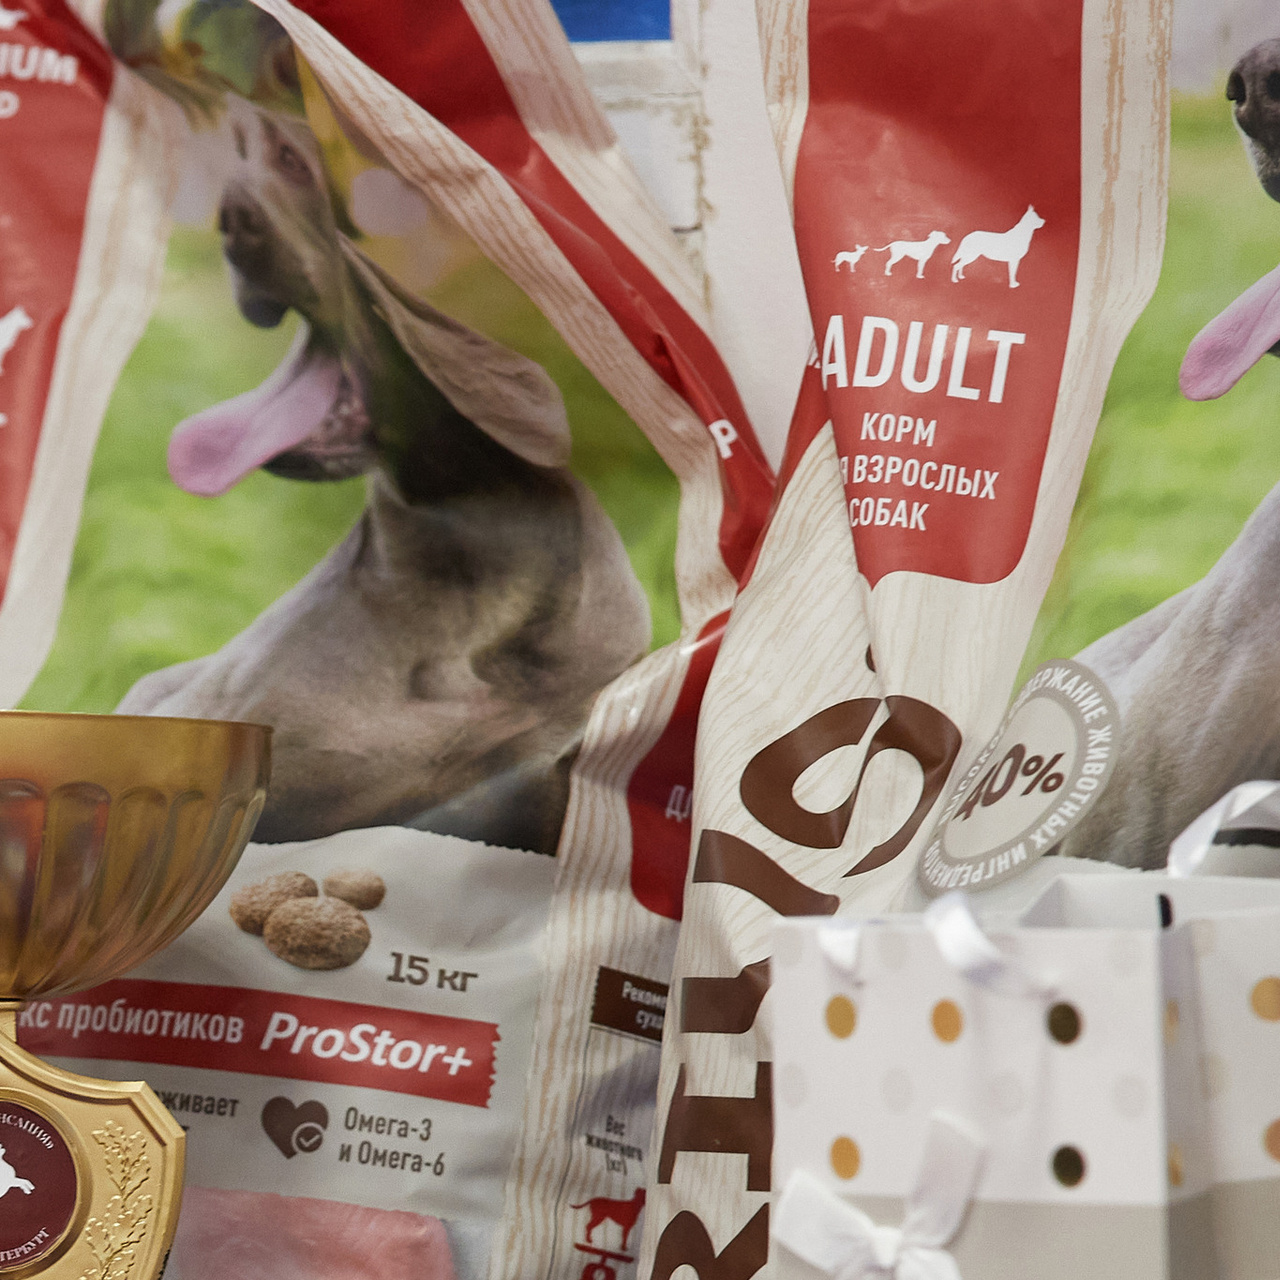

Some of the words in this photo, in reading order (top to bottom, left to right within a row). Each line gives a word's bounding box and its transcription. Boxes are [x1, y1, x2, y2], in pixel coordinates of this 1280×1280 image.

[822, 314, 1025, 403] ADULT
[860, 412, 937, 447] КОРМ
[852, 454, 999, 500] ВЗРОСЛЫХ
[849, 497, 930, 531] СОБАК
[1029, 724, 1112, 849] ЖИВОТНЫХ
[387, 952, 430, 986] 15
[436, 966, 479, 993] кг
[57, 999, 245, 1044] пробиотиков
[261, 1011, 473, 1077] ProStor+
[344, 1106, 433, 1143] Омега-3
[338, 1145, 352, 1165] и
[357, 1142, 447, 1179] Омега-6
